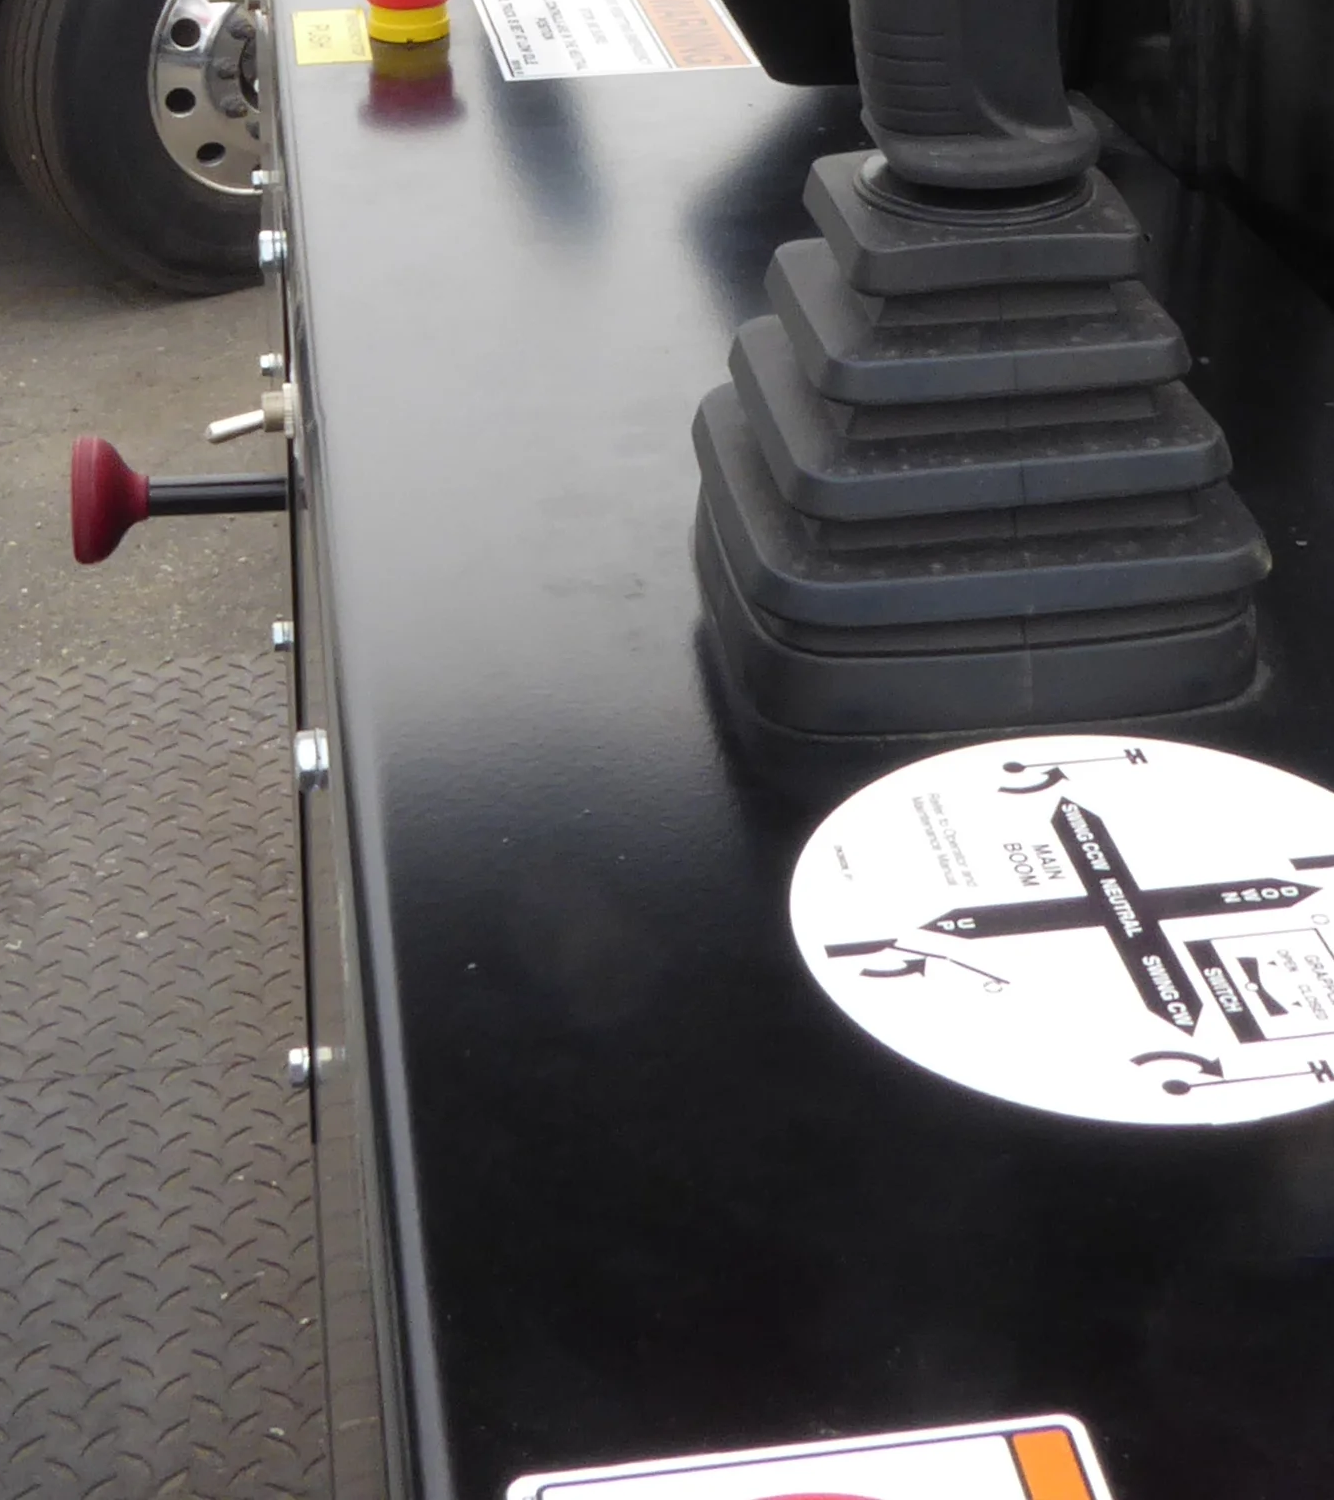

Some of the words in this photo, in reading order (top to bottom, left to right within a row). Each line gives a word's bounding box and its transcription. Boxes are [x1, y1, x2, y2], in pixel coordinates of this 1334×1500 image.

[1061, 803, 1093, 843] SWING
[1081, 840, 1111, 871] CCW
[1003, 842, 1040, 888] BOOM
[1032, 844, 1065, 880] MAIN
[1100, 878, 1143, 938] NEUTRAL
[1141, 955, 1180, 1001] SWING
[1167, 1001, 1194, 1028] CW
[1203, 967, 1243, 1013] SWITCH
[1298, 984, 1328, 1021] CLOSED
